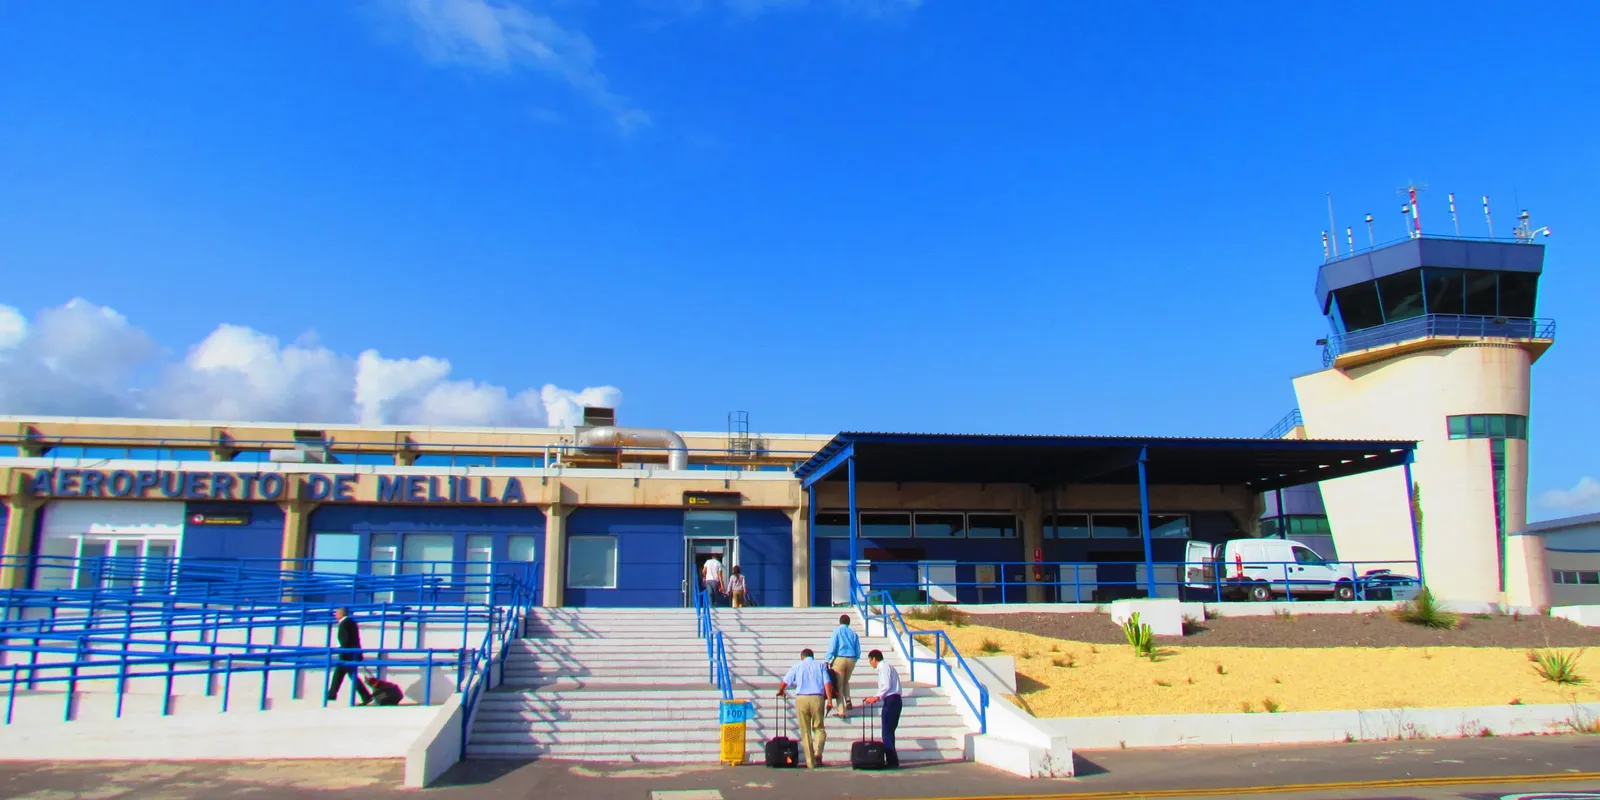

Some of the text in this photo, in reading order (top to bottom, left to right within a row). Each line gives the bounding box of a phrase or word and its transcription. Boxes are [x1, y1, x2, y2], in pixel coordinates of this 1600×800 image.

[31, 468, 526, 503] AEROPUERTO DE MELILLA
